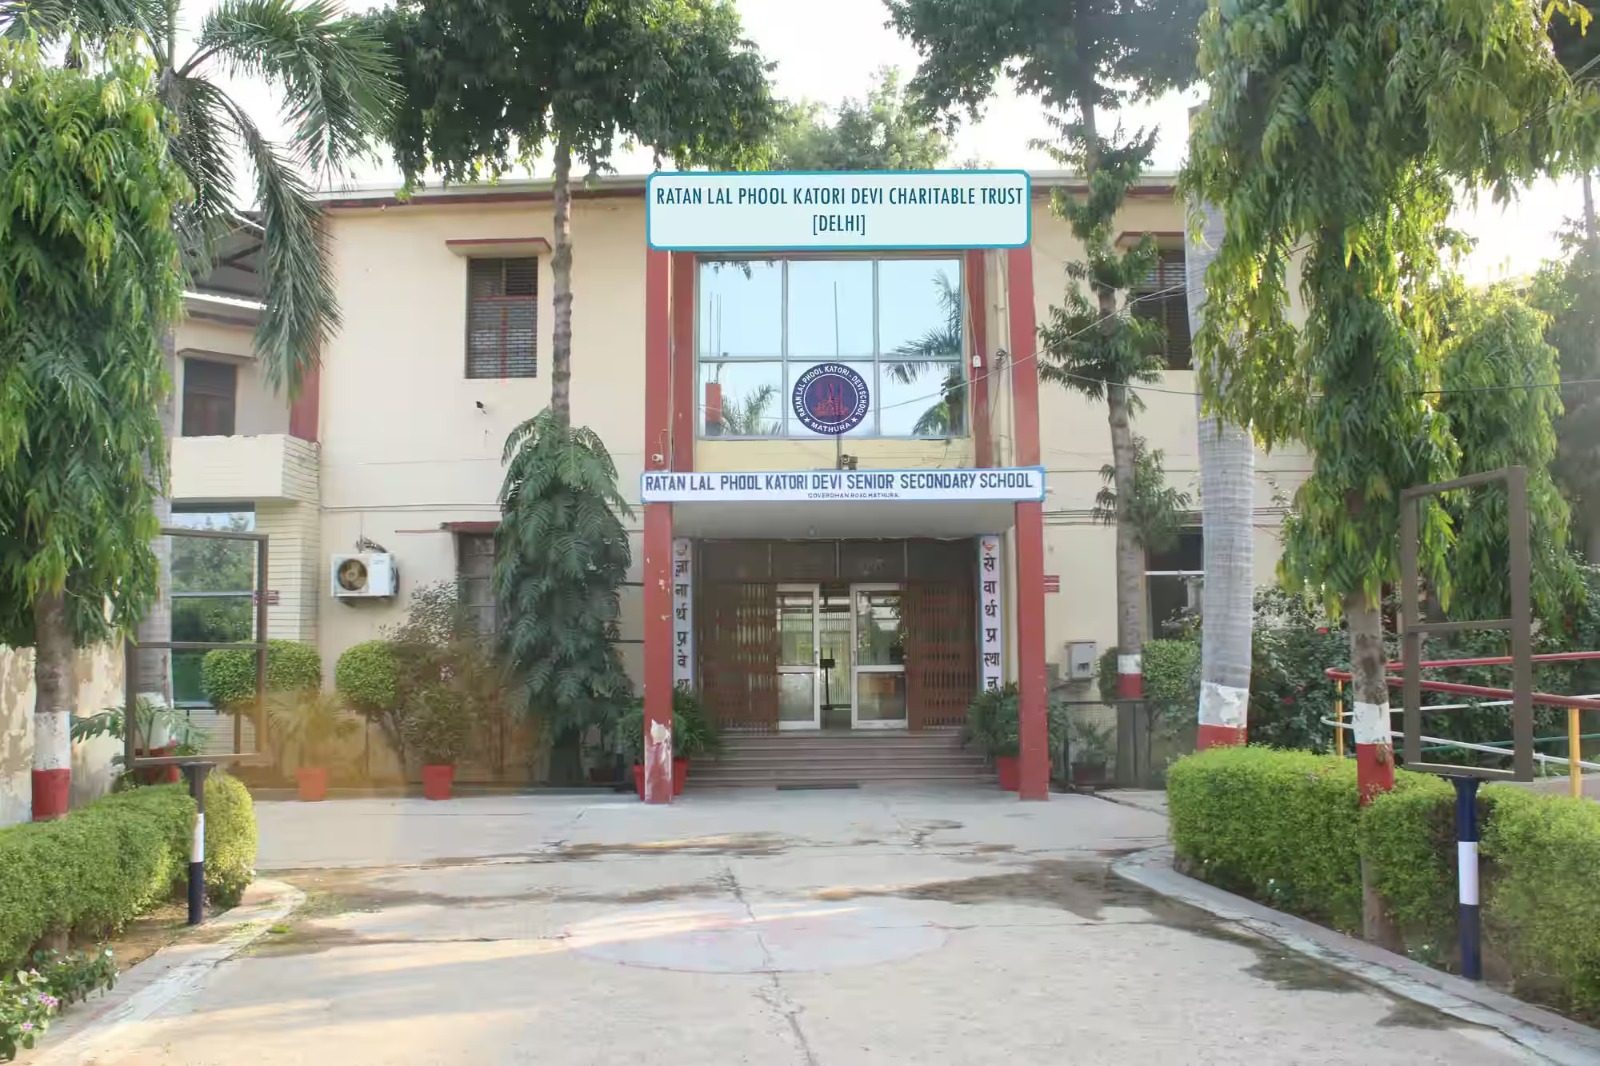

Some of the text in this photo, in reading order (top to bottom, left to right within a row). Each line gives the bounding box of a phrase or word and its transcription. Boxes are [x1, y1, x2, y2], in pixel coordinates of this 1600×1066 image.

[656, 187, 1023, 205] RATAN LAL PHOOL KATORI DEVI CHARITABLE TRUST
[813, 214, 866, 236] [DELHI]
[795, 366, 867, 417] RATAN LAL PHOOL KATORI DEVI SCHOOL
[811, 422, 850, 432] MATHURA
[645, 475, 686, 491] RATAN
[690, 475, 715, 491] LAL
[720, 475, 762, 490] PHOOL
[765, 475, 808, 490] KATORI
[812, 474, 842, 490] DEVI
[847, 474, 895, 489] SENIOR
[900, 473, 976, 489] SECONDARY
